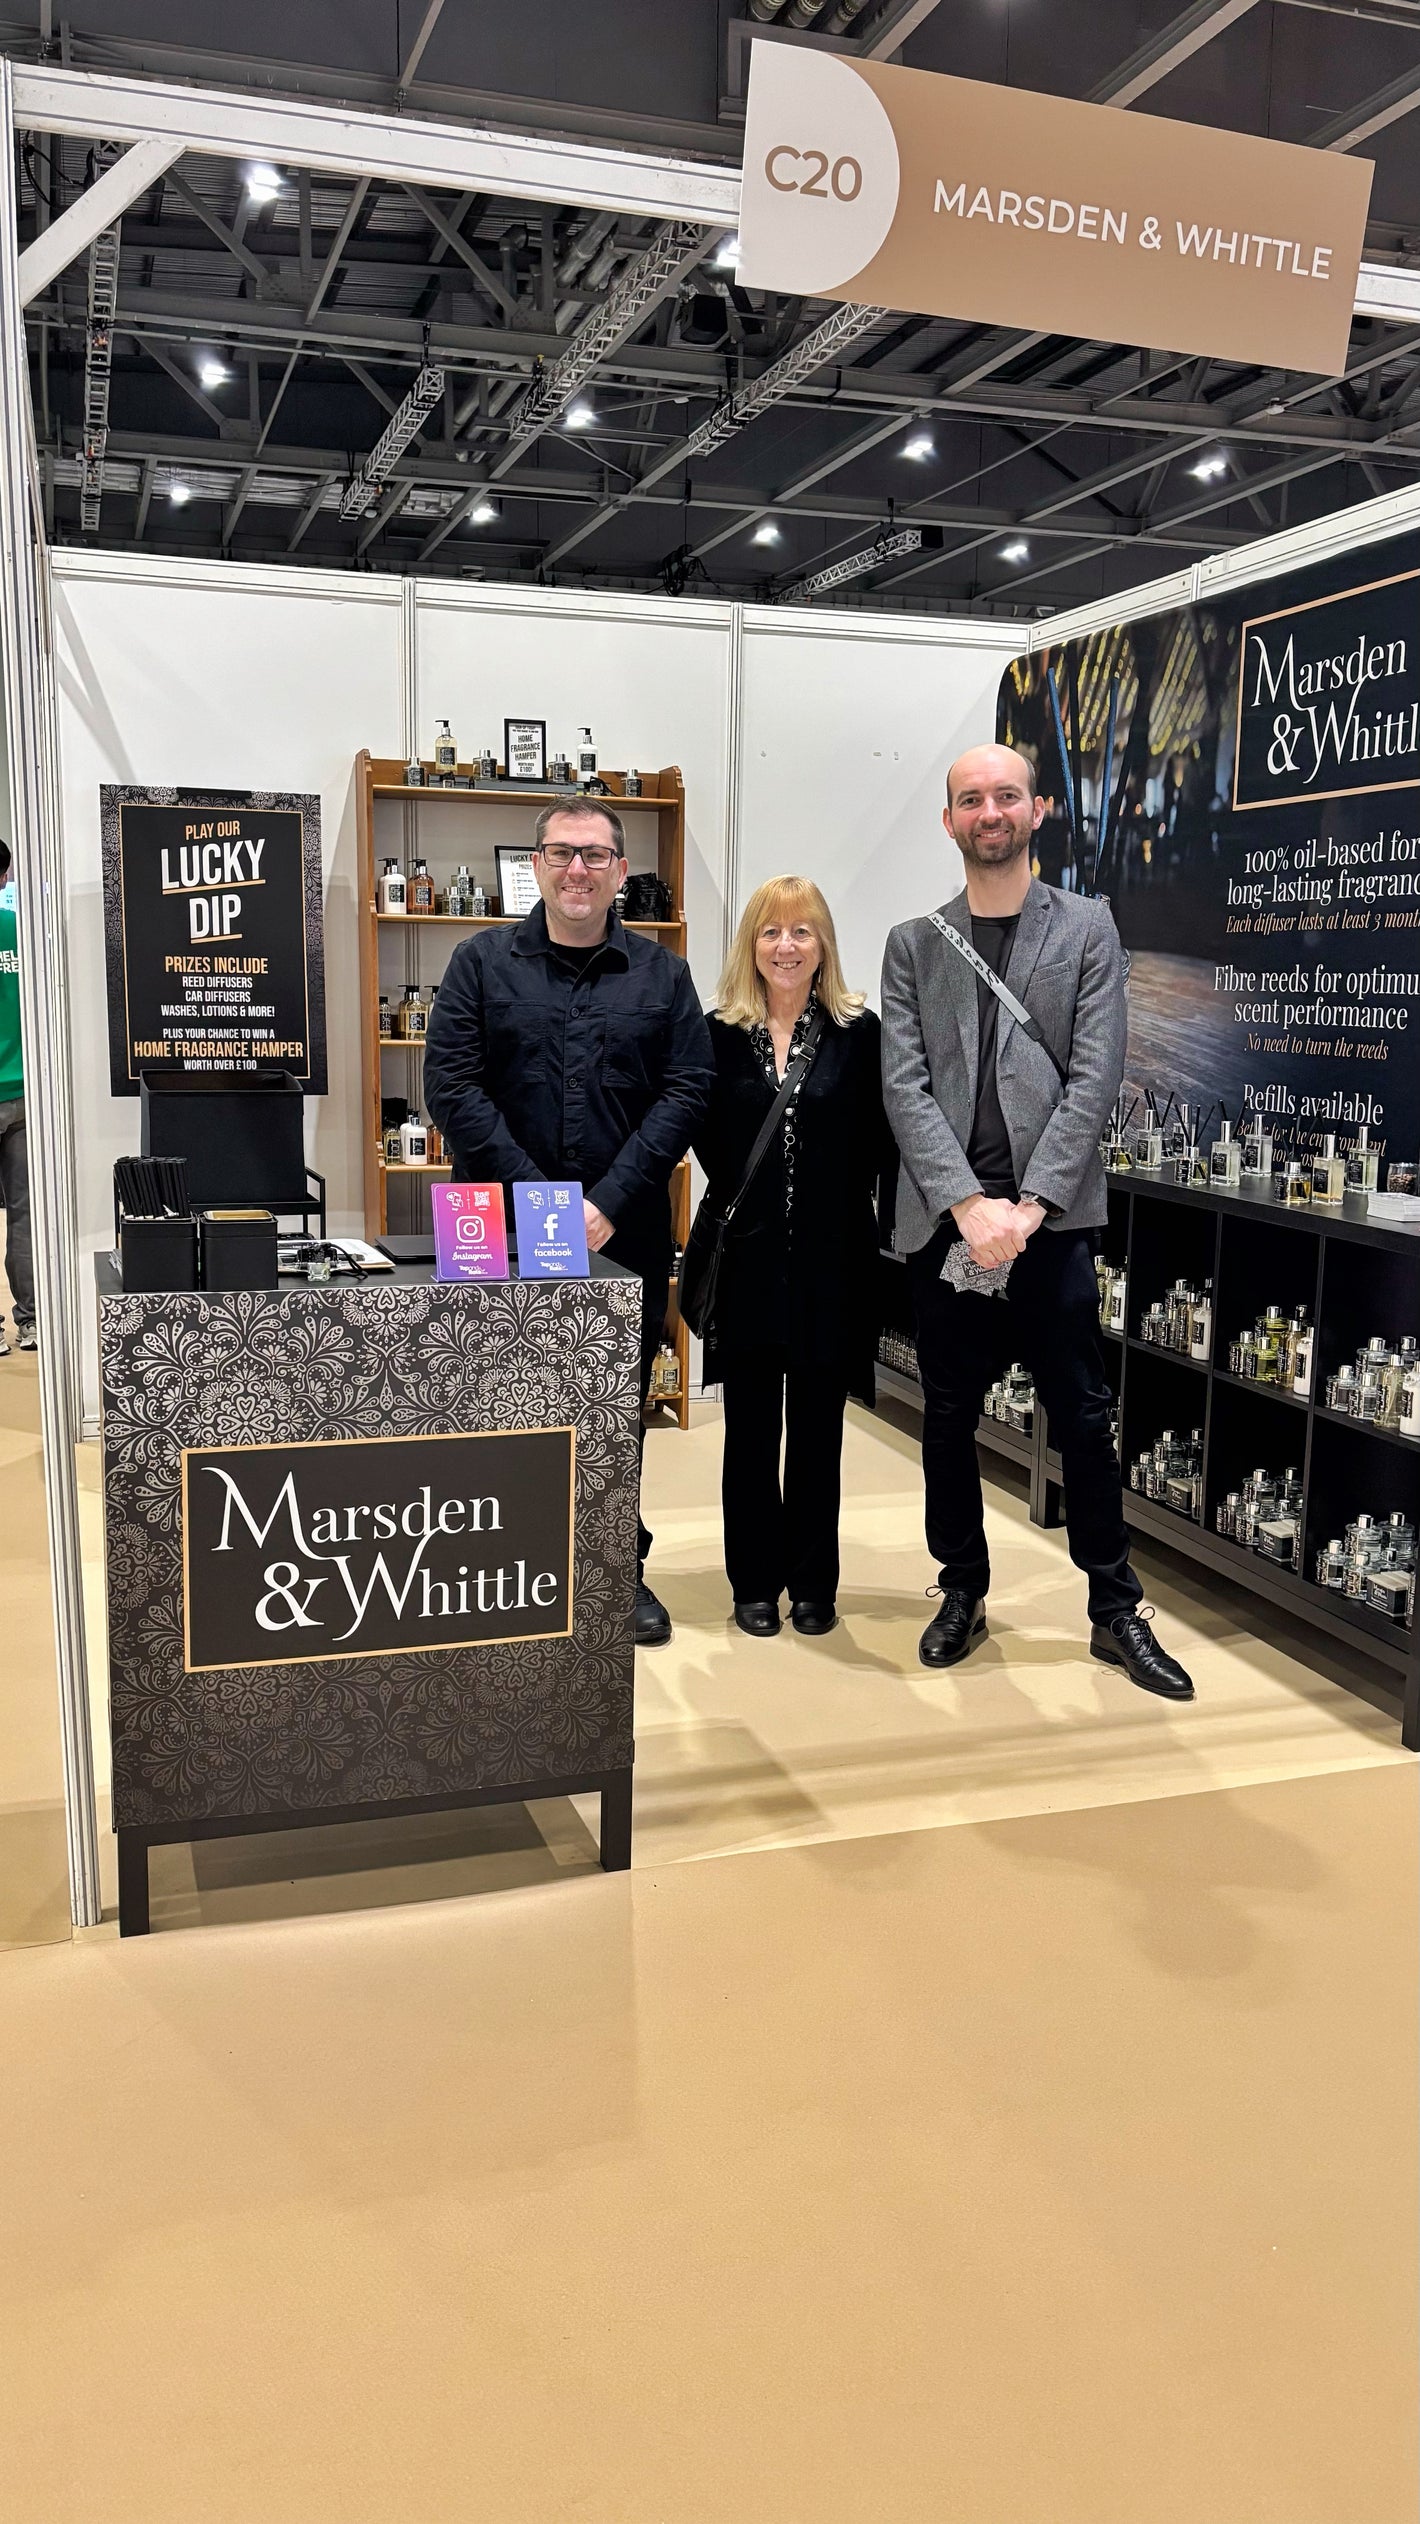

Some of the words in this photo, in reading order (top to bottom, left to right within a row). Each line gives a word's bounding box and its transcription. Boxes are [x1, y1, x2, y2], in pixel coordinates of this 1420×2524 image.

[764, 144, 864, 203] C20
[932, 178, 1128, 246] MARSDEN
[1138, 215, 1163, 251] &
[1175, 221, 1333, 280] WHITTLE
[1250, 632, 1408, 711] Marsden
[1266, 713, 1306, 776] &
[1302, 699, 1420, 784] Whittl
[185, 822, 214, 841] PLAY
[217, 820, 241, 837] OUR
[160, 838, 266, 890] LUCKY
[509, 854, 528, 863] LUCKY
[1243, 844, 1290, 874] 100%
[1294, 831, 1384, 869] oil-based
[1389, 829, 1420, 862] for
[1226, 872, 1334, 910] long-lasting
[1337, 868, 1420, 904] fragranc
[188, 893, 242, 940] DIP
[1225, 913, 1252, 933] Each
[1253, 912, 1297, 936] diffuser
[1297, 911, 1325, 931] lasts
[1326, 911, 1340, 930] at
[1341, 908, 1371, 930] least
[1371, 913, 1382, 932] 3
[164, 955, 211, 974] PRIZES
[214, 957, 269, 974] INCLUDE
[182, 975, 205, 988] REED
[206, 976, 253, 989] DIFFUSERS
[185, 990, 202, 1002] CAR
[204, 991, 251, 1003] DIFFUSERS
[1213, 964, 1256, 992] Fibre
[1260, 964, 1309, 993] reeds
[1313, 963, 1343, 993] for
[1346, 964, 1420, 1000] optimu
[161, 1004, 200, 1018] WASHES,
[201, 1004, 238, 1017] LOTIONS
[239, 1005, 246, 1017] &
[247, 1005, 275, 1017] MORE!
[1234, 999, 1280, 1024] scent
[1282, 996, 1409, 1030] performance
[134, 1041, 172, 1058] HOME
[174, 1041, 249, 1058] FRAGRANCE
[251, 1041, 304, 1058] HAMPER
[162, 1028, 183, 1039] PLUS
[185, 1028, 206, 1039] YOUR
[207, 1028, 238, 1040] CHANCE
[240, 1028, 250, 1040] TO
[252, 1028, 266, 1040] WIN
[268, 1028, 275, 1040] A
[1244, 1032, 1261, 1051] No
[1263, 1034, 1290, 1053] need
[1291, 1036, 1303, 1054] to
[1305, 1037, 1331, 1056] turn
[1334, 1036, 1353, 1058] the
[1355, 1039, 1389, 1061] reeds
[184, 1059, 213, 1070] WORTH
[214, 1059, 234, 1070] OVER
[236, 1059, 257, 1070] £100
[1243, 1083, 1296, 1115] Refills
[1300, 1090, 1384, 1126] available
[452, 1251, 493, 1262] Instagram
[534, 1247, 573, 1257] facebook
[201, 1466, 504, 1561] Marsden
[254, 1561, 329, 1632] &
[332, 1549, 559, 1642] Whittle
